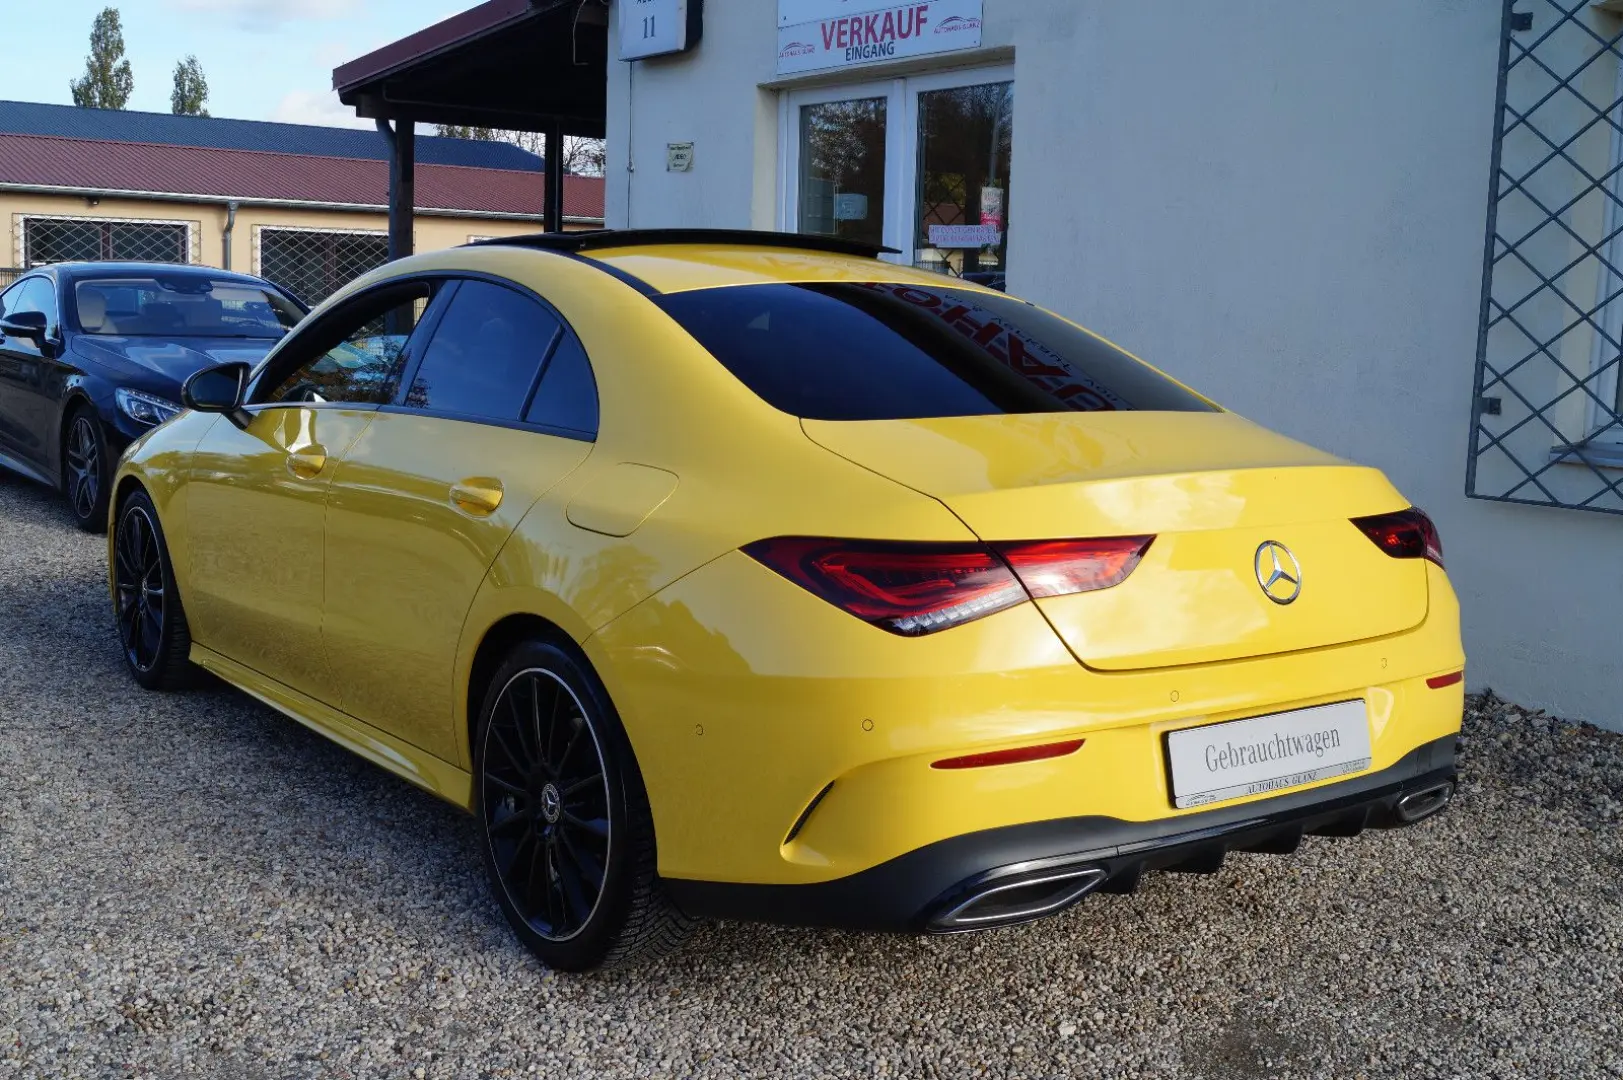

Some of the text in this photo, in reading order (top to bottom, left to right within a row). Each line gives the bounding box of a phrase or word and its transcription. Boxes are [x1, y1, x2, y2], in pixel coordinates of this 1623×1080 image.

[642, 14, 656, 40] 11
[821, 5, 928, 51] VERKAUF
[845, 41, 894, 62] EINGANG
[1205, 728, 1341, 773] Gebrauchtwagen
[1247, 771, 1318, 794] AUTOHAUS GLANZ
